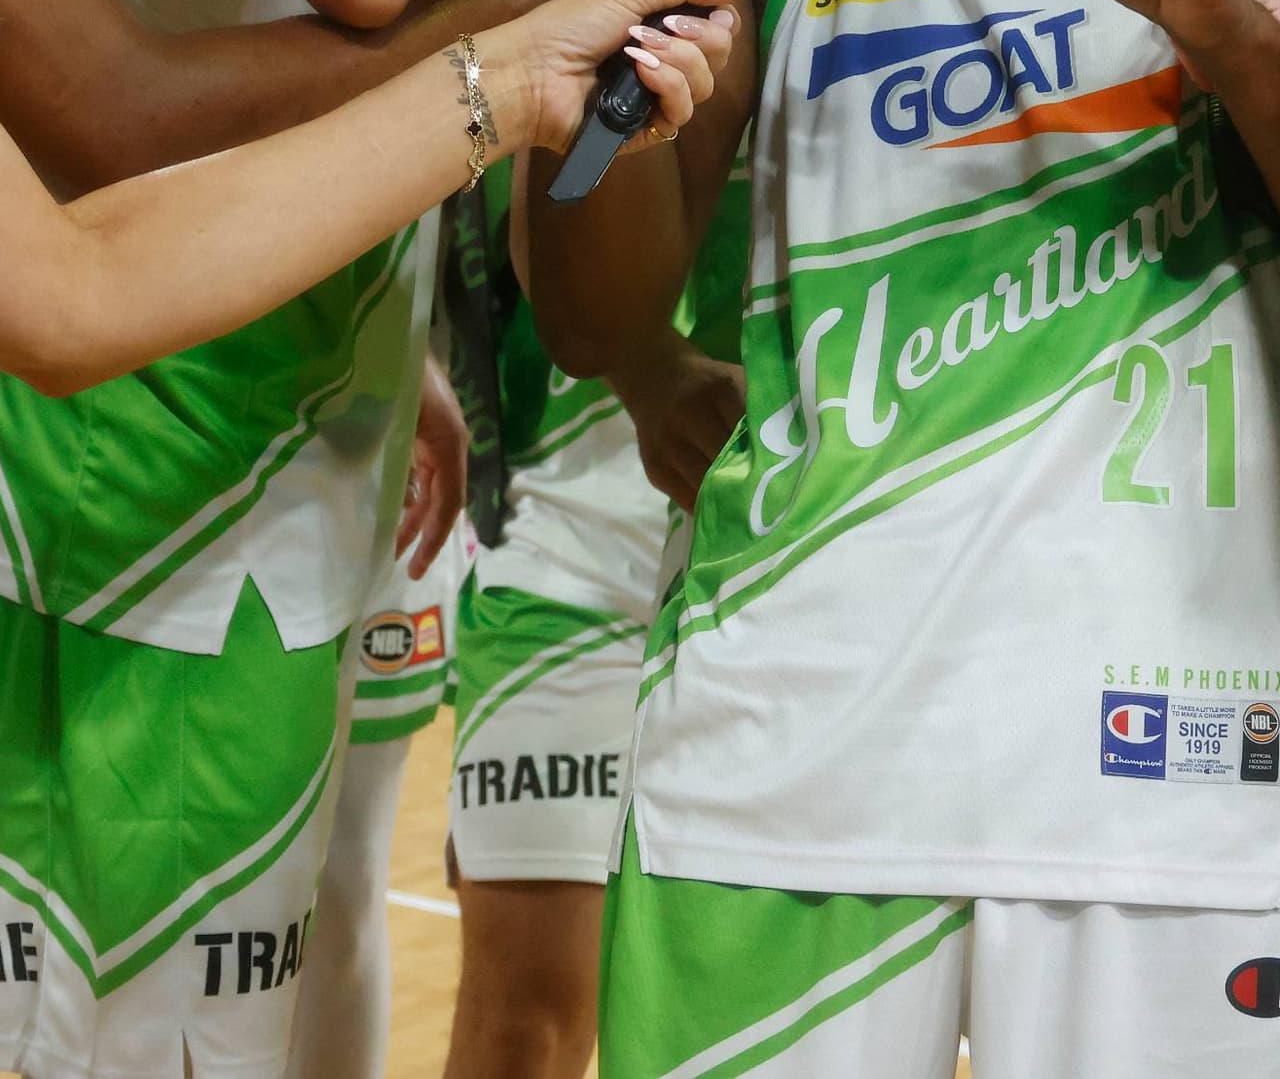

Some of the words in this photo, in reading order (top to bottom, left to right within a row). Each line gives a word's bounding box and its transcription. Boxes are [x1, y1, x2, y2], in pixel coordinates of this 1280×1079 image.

[870, 8, 1085, 146] GOAT
[749, 142, 1218, 536] Heartland
[1101, 338, 1241, 509] 21
[1103, 664, 1169, 687] S.E.M
[1178, 721, 1229, 739] SINCE
[1250, 714, 1273, 731] NBL
[1185, 739, 1221, 755] 1919
[1103, 752, 1163, 769] Champion
[458, 754, 619, 810] TRADIE
